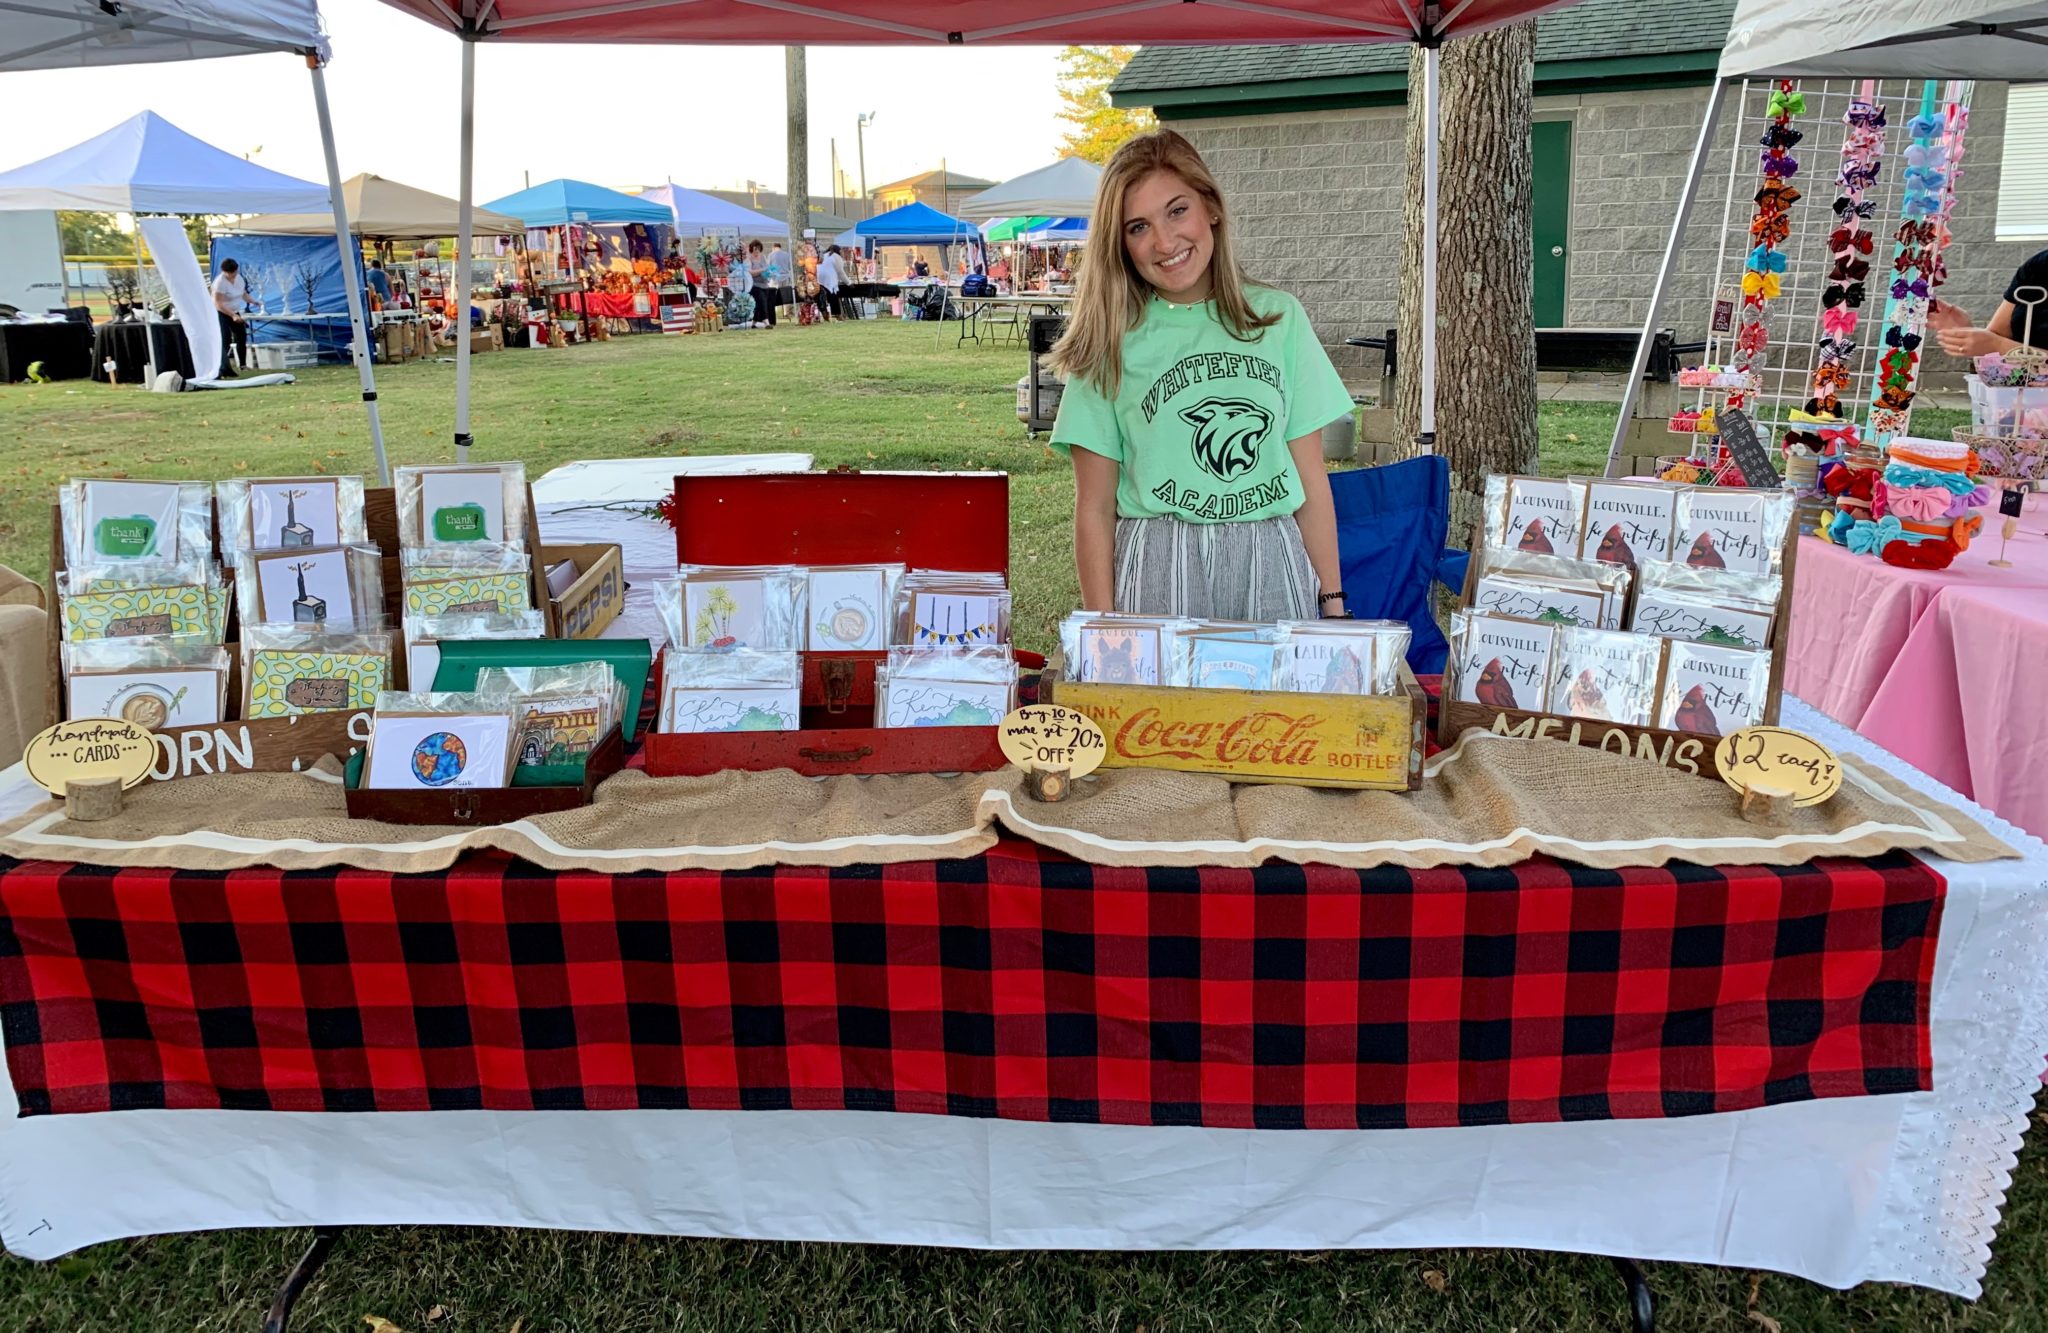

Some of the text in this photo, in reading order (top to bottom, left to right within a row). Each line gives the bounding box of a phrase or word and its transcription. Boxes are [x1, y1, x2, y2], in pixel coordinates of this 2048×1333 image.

[1141, 351, 1286, 424] WHITEFIEL
[1152, 468, 1289, 519] ACADEM
[1515, 495, 1576, 512] LOUISVILL
[1593, 499, 1666, 519] LOUISVILLE.
[1686, 508, 1757, 523] OUISVILLE.
[566, 566, 617, 639] PEPSI
[1681, 659, 1752, 681] OUISVILLE.
[1674, 682, 1752, 718] entucky
[1019, 708, 1082, 724] Buy 10 or
[1071, 705, 1121, 720] RINK
[46, 724, 142, 746] handmade
[1007, 723, 1104, 748] more get 20%
[73, 743, 121, 764] CARDS
[147, 725, 255, 782] ORN
[1037, 746, 1075, 763] OFF!
[1725, 732, 1837, 786] $2 each!
